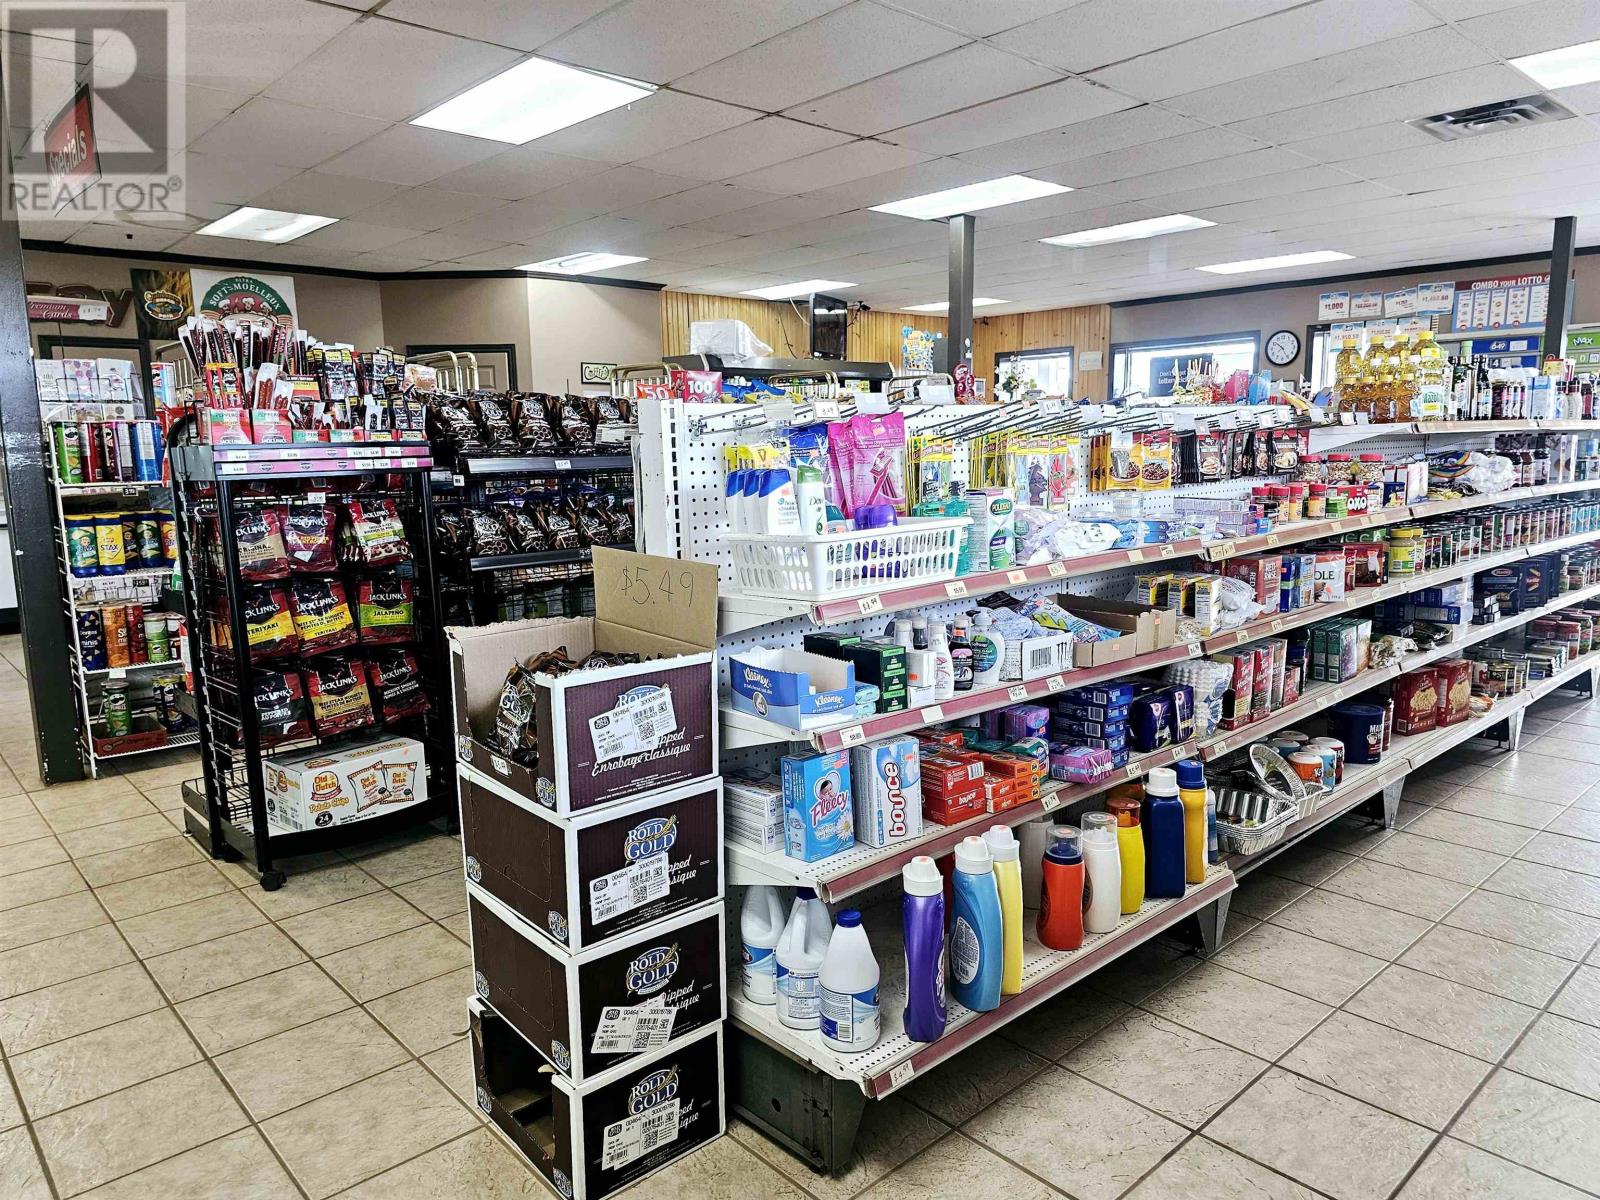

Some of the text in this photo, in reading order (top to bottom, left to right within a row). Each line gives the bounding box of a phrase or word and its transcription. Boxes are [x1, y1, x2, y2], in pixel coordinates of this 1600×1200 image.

[50, 125, 88, 187] Specials
[1471, 280, 1499, 290] COMBO
[1499, 279, 1516, 287] YOUR
[1517, 275, 1542, 285] LOTTO
[209, 286, 229, 306] SOFT
[233, 283, 280, 310] MOELLEUX
[42, 310, 73, 320] Cards
[688, 381, 713, 393] 100
[1347, 496, 1367, 511] OXO
[621, 564, 694, 608] $5.49
[246, 622, 279, 636] TERIYAKI
[814, 695, 843, 708] Kleenex
[592, 753, 645, 778] Enrobage
[314, 774, 328, 785] Old
[314, 781, 337, 792] Dutch
[810, 789, 849, 828] Fleecy
[883, 762, 907, 838] bounce
[628, 823, 663, 843] ROLD
[627, 833, 675, 860] GOLD
[630, 952, 666, 974] ROLD
[629, 961, 678, 990] GOLD
[666, 979, 695, 1003] ipped
[631, 1074, 666, 1099] ROLD
[631, 1082, 678, 1115] GOLD
